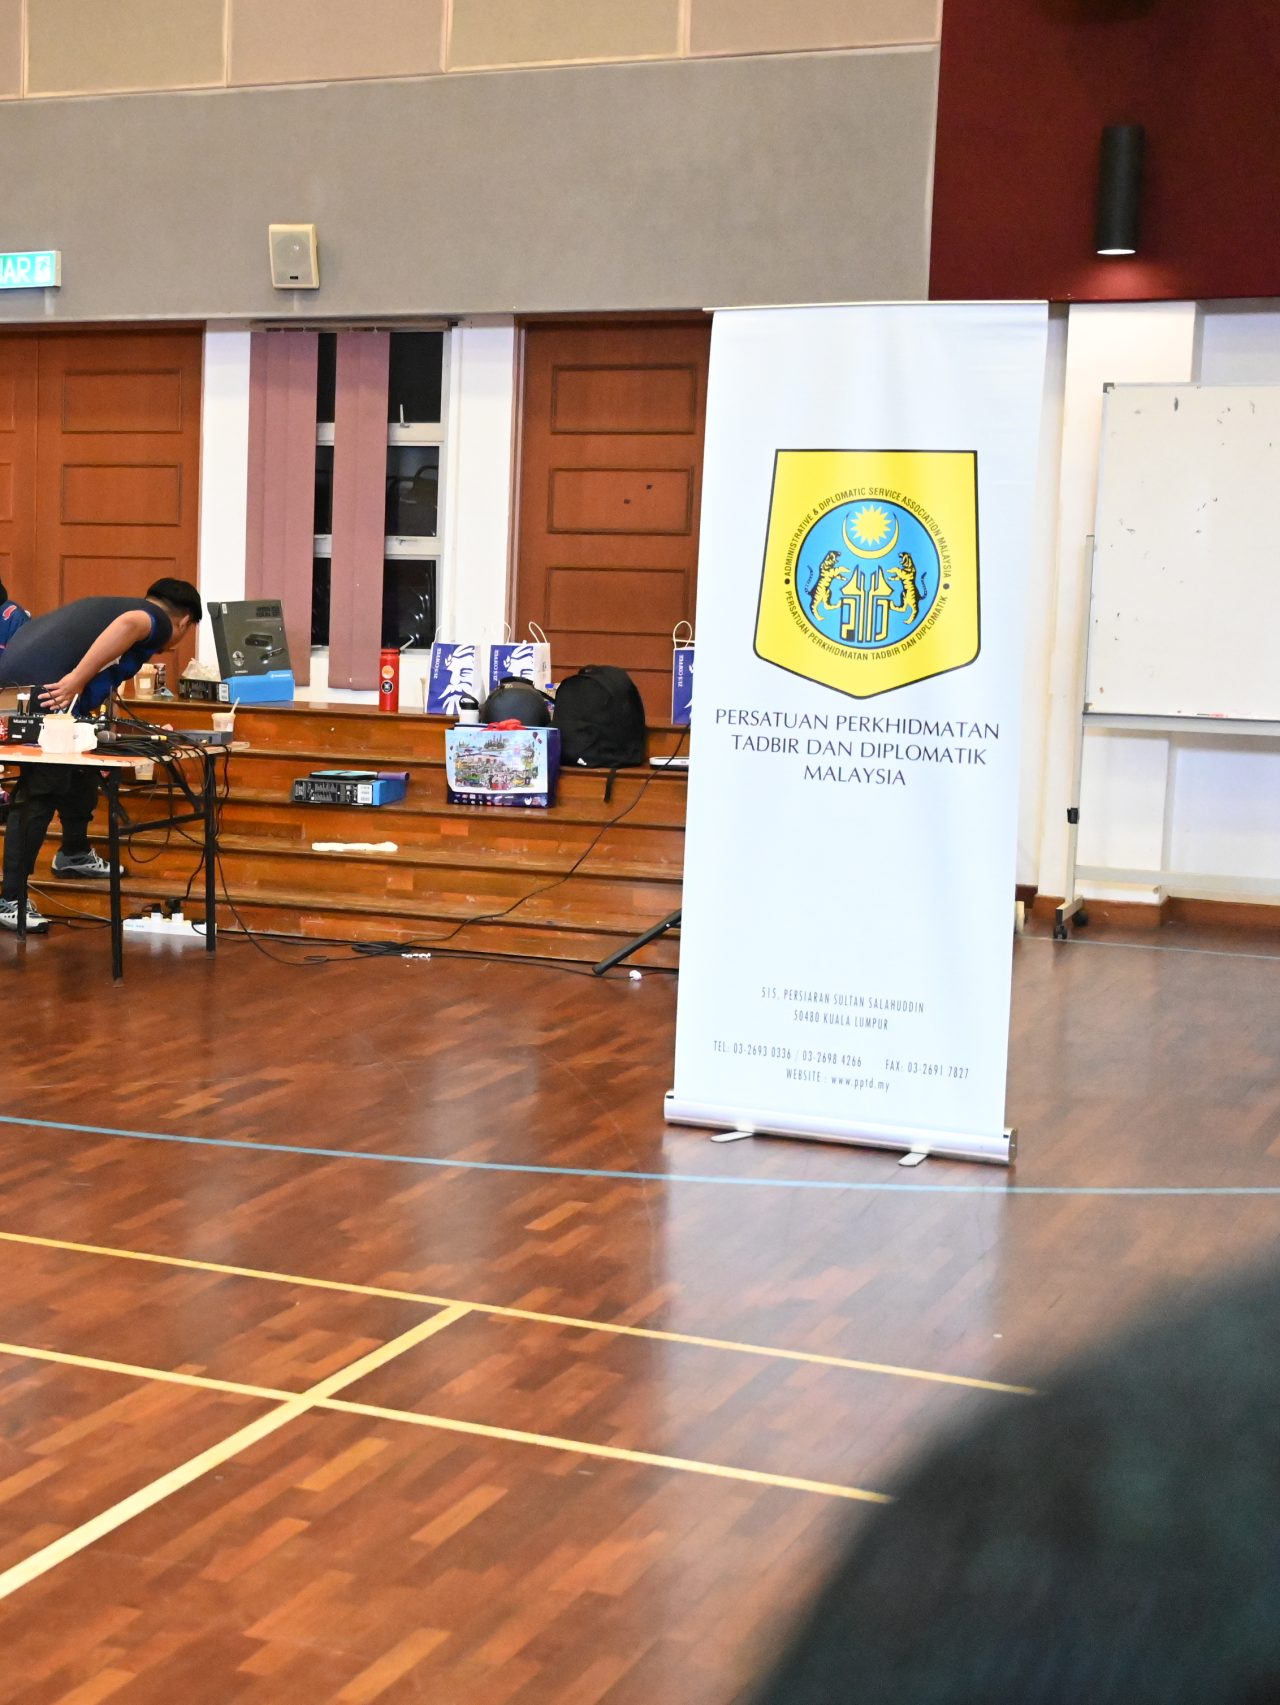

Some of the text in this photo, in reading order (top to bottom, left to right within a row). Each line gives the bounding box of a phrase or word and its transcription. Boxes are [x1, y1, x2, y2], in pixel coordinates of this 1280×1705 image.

[785, 514, 814, 577] ADMINISTRATIVE
[818, 487, 866, 511] DIPLOMATIC
[868, 487, 902, 501] SERVICE
[900, 496, 941, 538] ASSOCIATION
[936, 536, 952, 578] MALAYSIA
[785, 590, 949, 661] PERSATUAN PERKHIDMATAN TADBIR DAN DIPLOMATIK
[715, 708, 999, 739] PERSATUAN PERKHIDMATAN
[731, 734, 987, 766] TADBIR DAN DIPLOMATIK
[804, 764, 906, 786] MALAYSIA
[783, 988, 830, 1004] PERSIARAN
[833, 993, 865, 1007] SULTAN
[868, 996, 924, 1013] SALAHUDDIN
[794, 1009, 888, 1031] 50480 KUALA LUMPUR
[771, 1046, 791, 1060] 0336
[841, 1054, 862, 1068] 4266
[948, 1066, 969, 1080] 7827
[786, 1067, 822, 1083] WEBSITE
